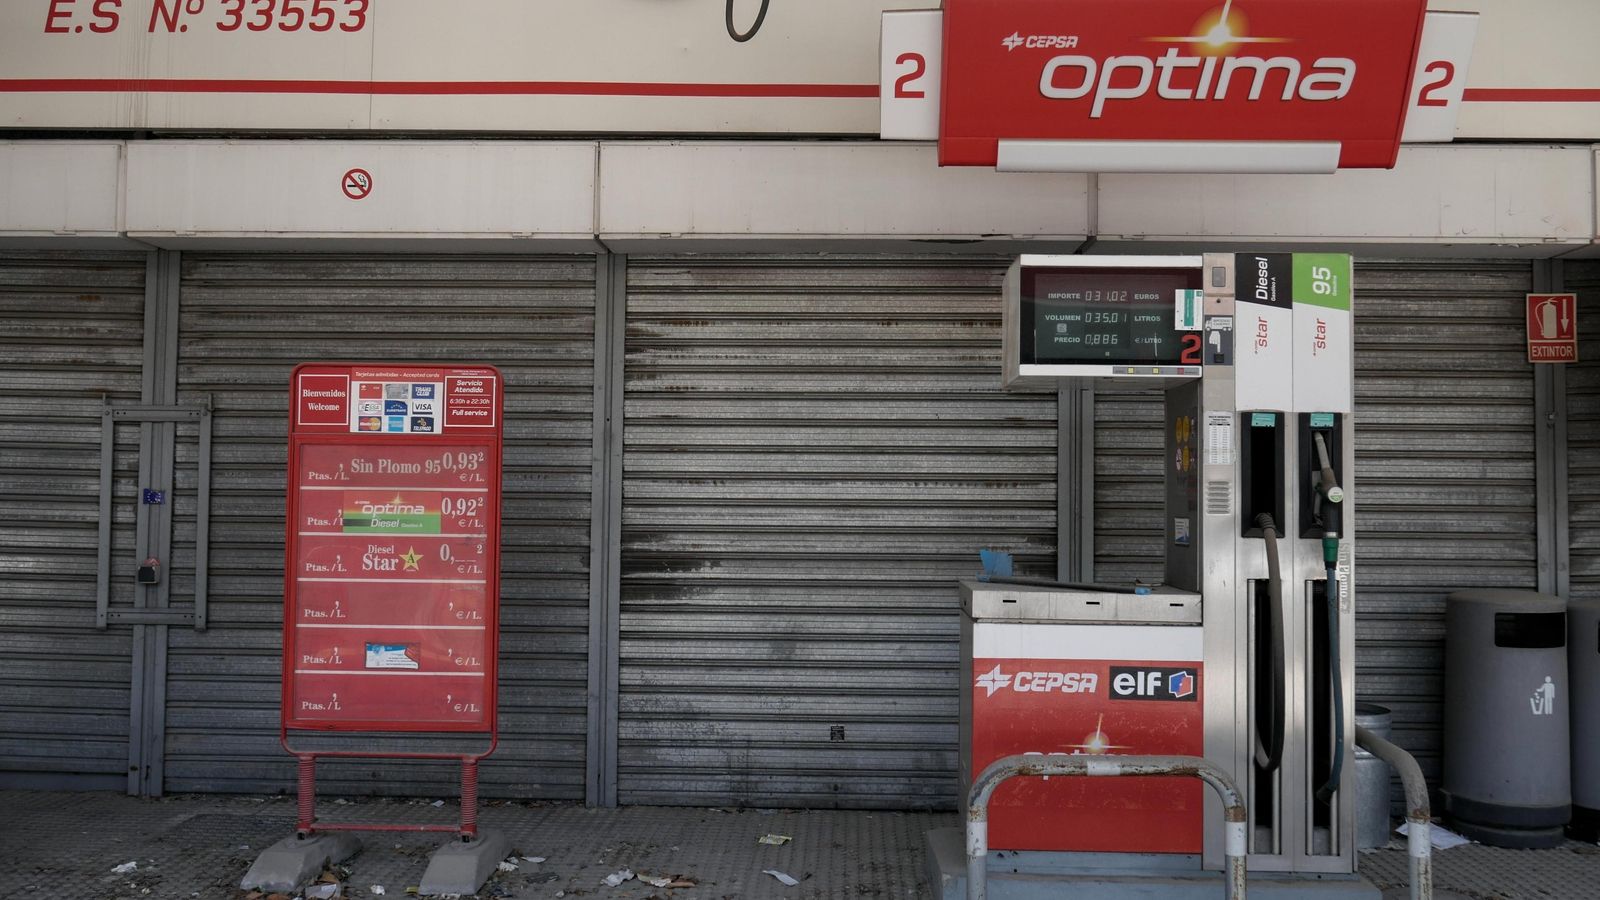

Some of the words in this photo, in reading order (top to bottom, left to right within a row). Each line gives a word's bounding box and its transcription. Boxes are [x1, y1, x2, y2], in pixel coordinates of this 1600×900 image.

[45, 0, 121, 33] E.S
[216, 0, 369, 32] 33553
[1025, 35, 1077, 48] CEPSA
[894, 54, 927, 99] 2
[1039, 48, 1356, 119] optima
[1416, 61, 1455, 107] 2
[1255, 257, 1268, 301] Diesel
[1312, 266, 1331, 296] 95
[1257, 316, 1269, 348] star
[1315, 318, 1327, 350] star
[1180, 333, 1202, 364] 2
[1532, 346, 1573, 358] EXTINTOR
[355, 371, 376, 379] Tarjetas
[403, 372, 427, 380] Accepted
[456, 379, 483, 387] Servicio
[303, 389, 346, 399] Bienvenidos
[454, 386, 484, 394] Atendido
[308, 402, 340, 412] Welcome
[415, 403, 432, 411] VISA
[452, 409, 465, 418] Full
[466, 410, 489, 418] service
[351, 459, 373, 473] Sin
[377, 459, 421, 474] Plomo
[425, 460, 442, 474] 95
[308, 472, 333, 481] Ptas.
[362, 501, 425, 518] optima
[307, 517, 331, 527] Ptas.
[370, 518, 401, 529] Diesel
[368, 544, 395, 555] Diesel
[306, 563, 330, 572] Ptas.
[362, 554, 399, 572] Star
[408, 553, 416, 565] A
[1339, 565, 1350, 598] Plomo
[304, 609, 329, 618] Ptas.
[303, 655, 327, 664] Ptas.
[1013, 671, 1099, 694] CEPSA
[1113, 671, 1162, 696] elf
[302, 701, 326, 711] Ptas.
